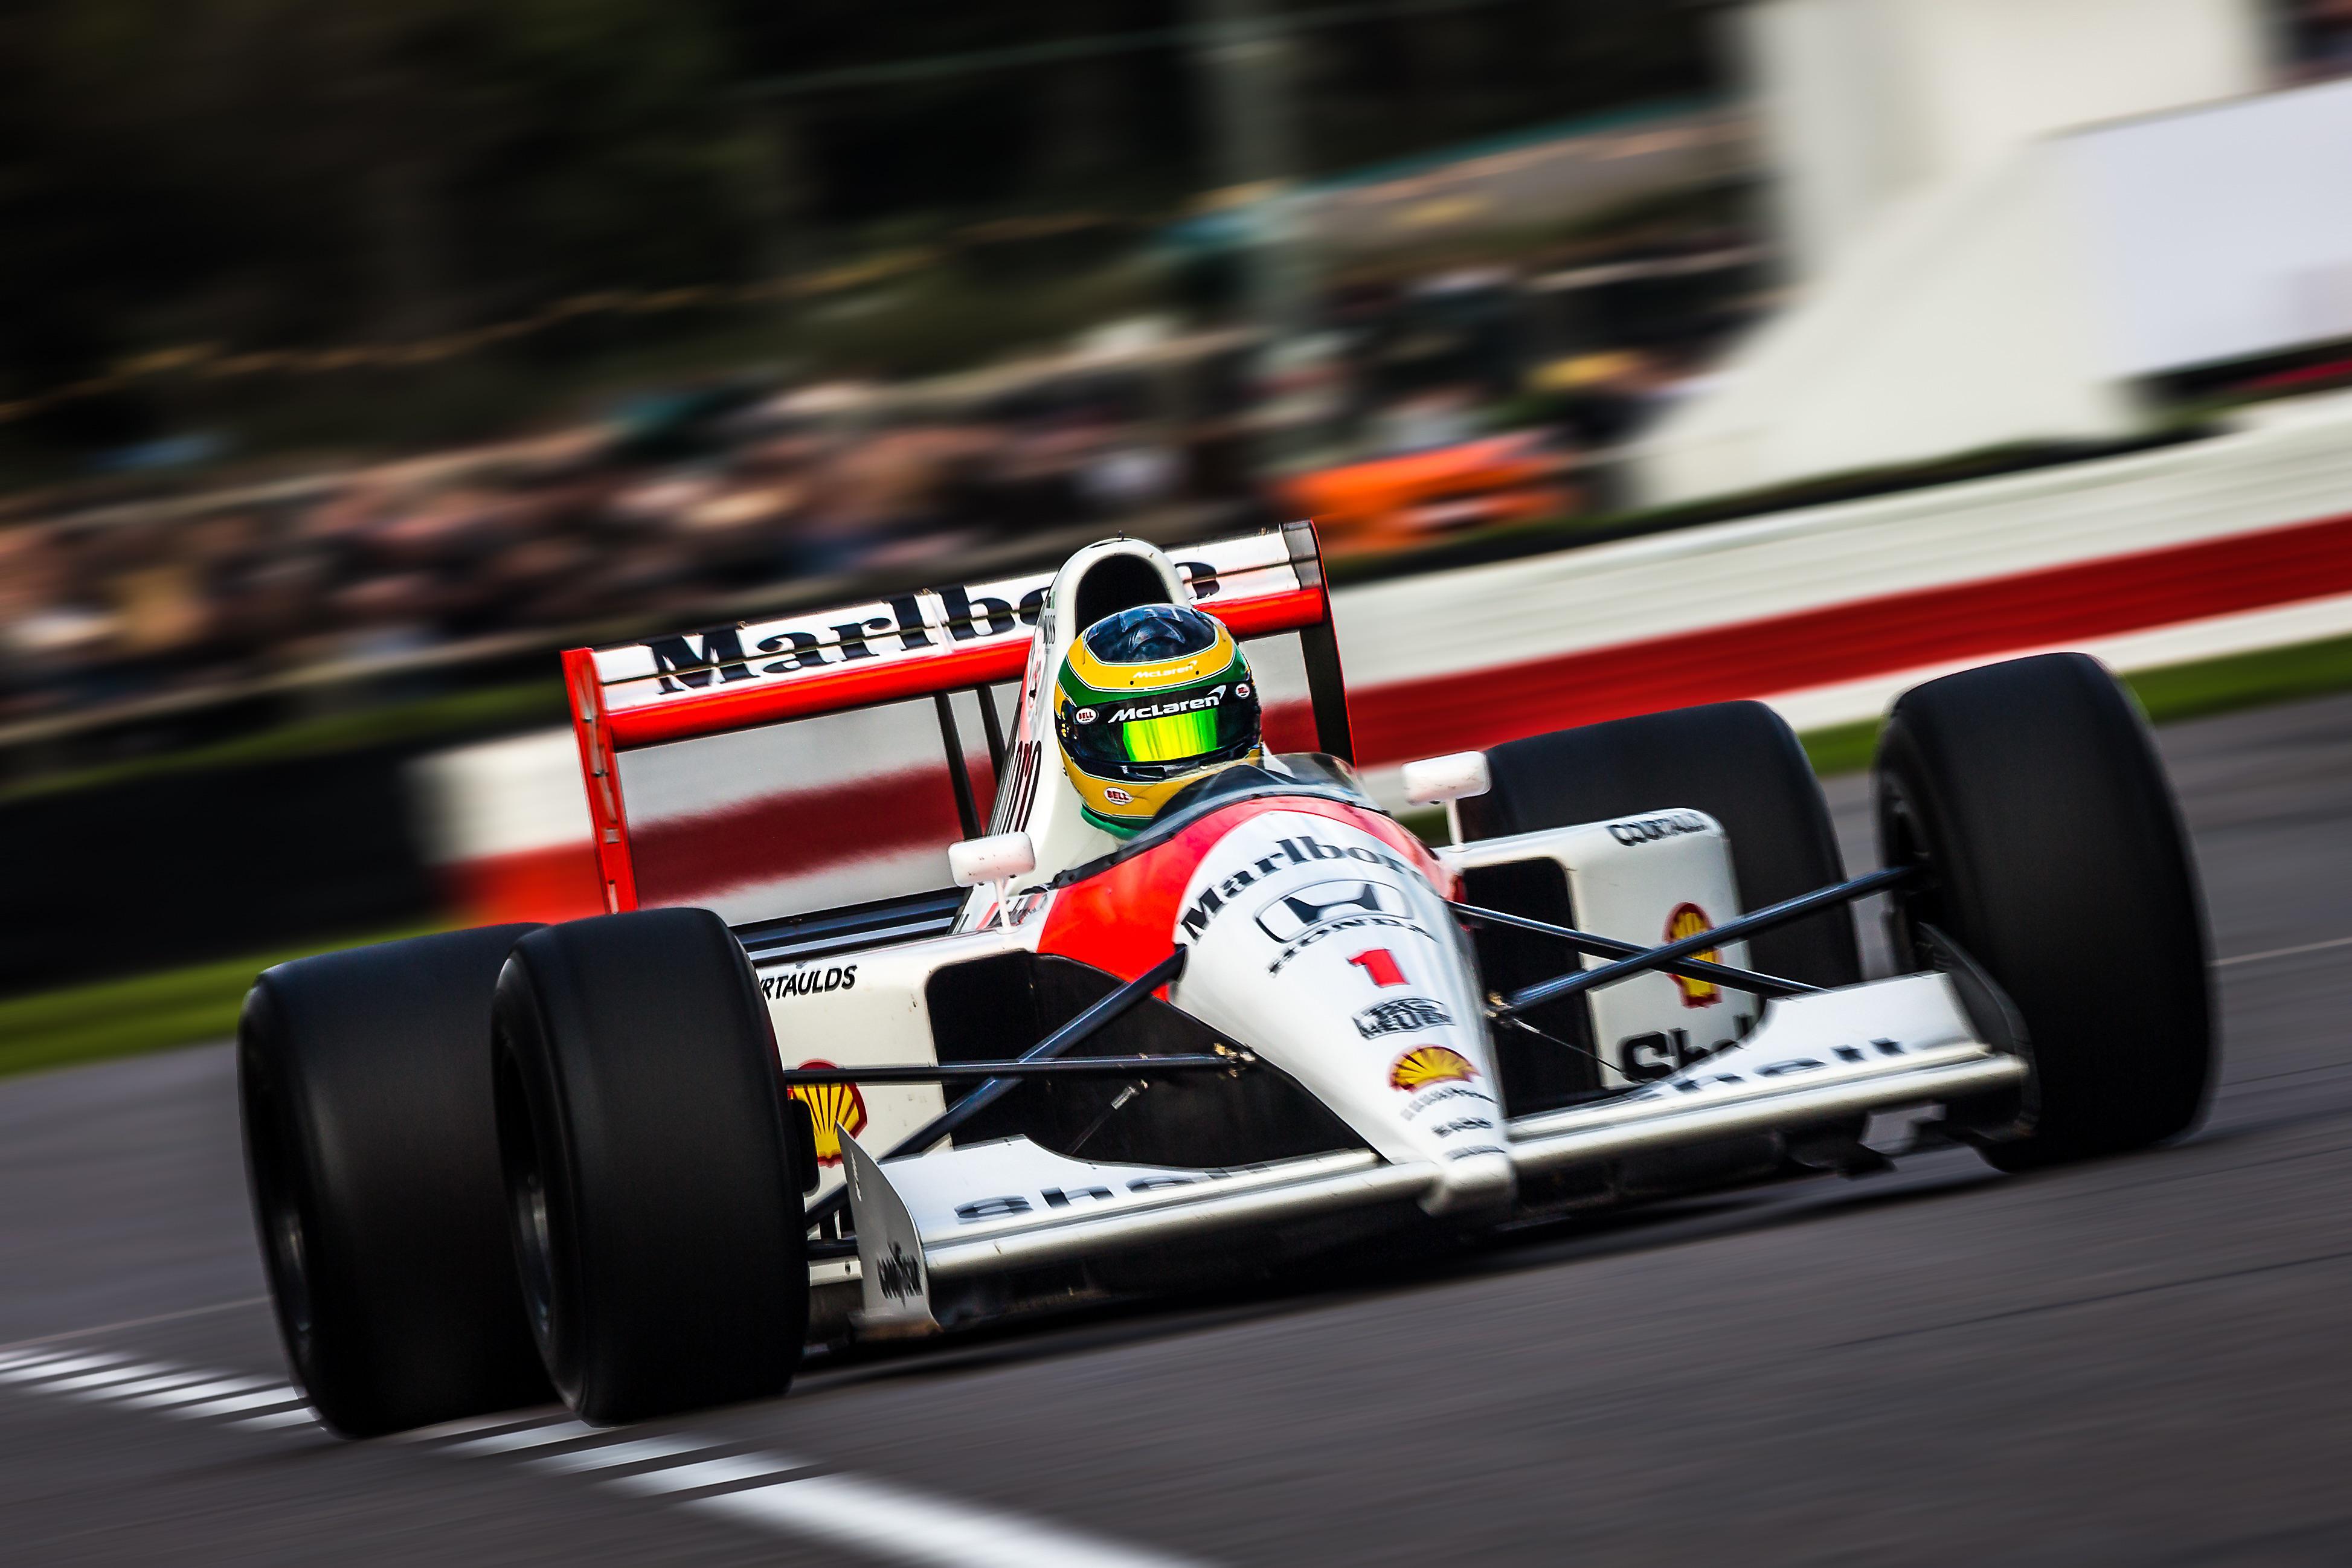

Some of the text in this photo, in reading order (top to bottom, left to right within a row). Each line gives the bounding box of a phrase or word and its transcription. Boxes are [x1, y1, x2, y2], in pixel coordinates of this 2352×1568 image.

[646, 561, 1220, 693] Marlboo
[1133, 664, 1194, 678] McLaren
[1108, 695, 1219, 724] McLaren
[1107, 790, 1129, 800] BELL
[1178, 835, 1446, 945] Marlboro
[1346, 947, 1410, 988] 1
